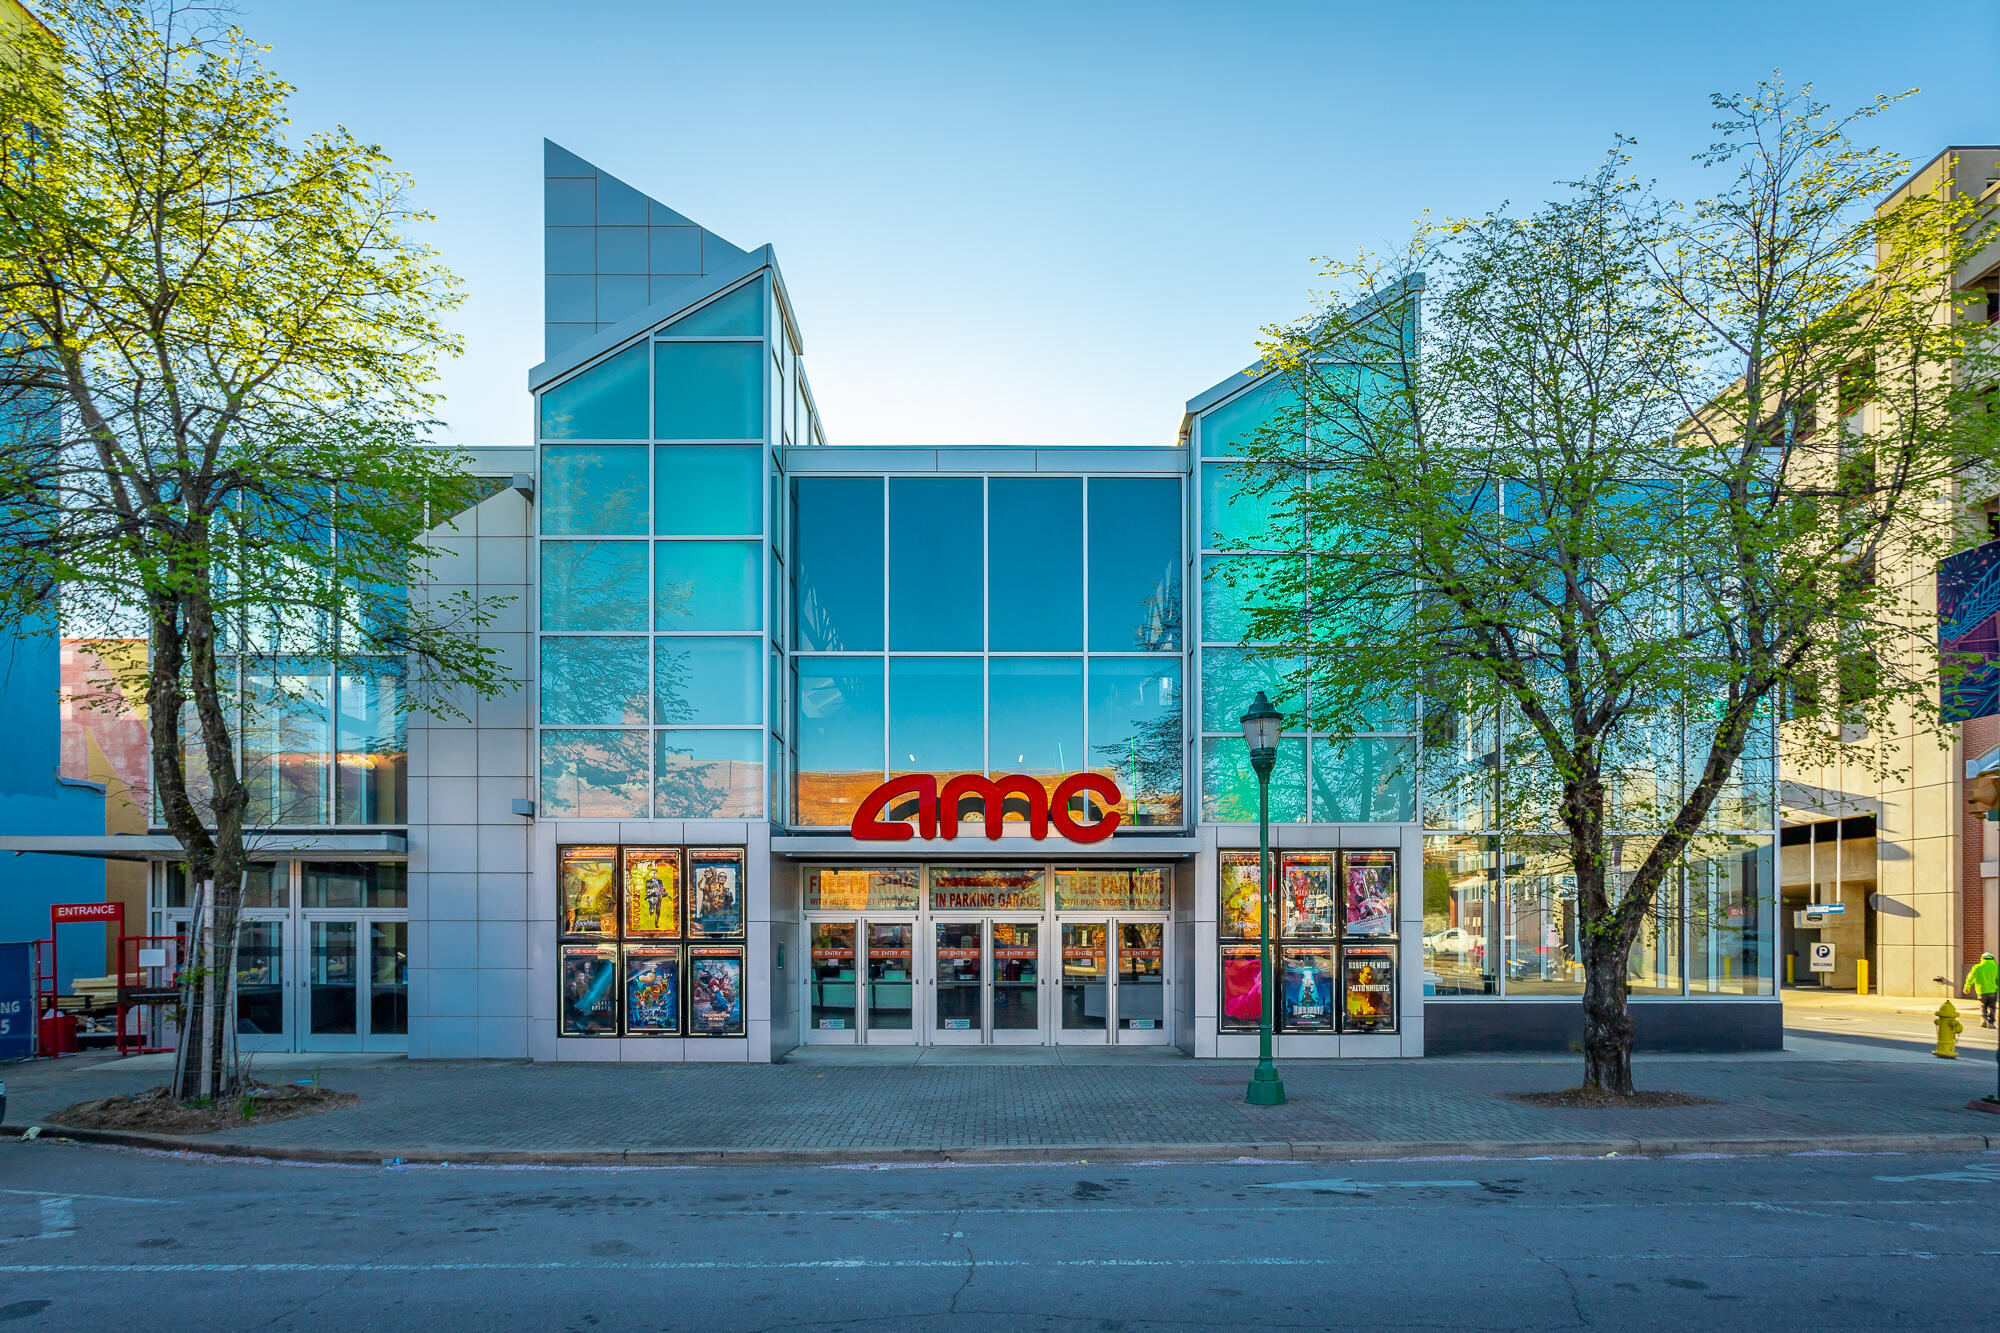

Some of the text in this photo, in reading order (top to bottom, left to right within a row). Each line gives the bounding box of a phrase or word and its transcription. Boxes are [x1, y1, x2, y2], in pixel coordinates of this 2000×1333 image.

[809, 876, 845, 894] FREE
[1060, 876, 1165, 894] FREE PARKING
[935, 893, 1040, 907] IN PARKING GARAGE
[1102, 898, 1126, 906] TICKET
[58, 905, 115, 916] ENTRANCE
